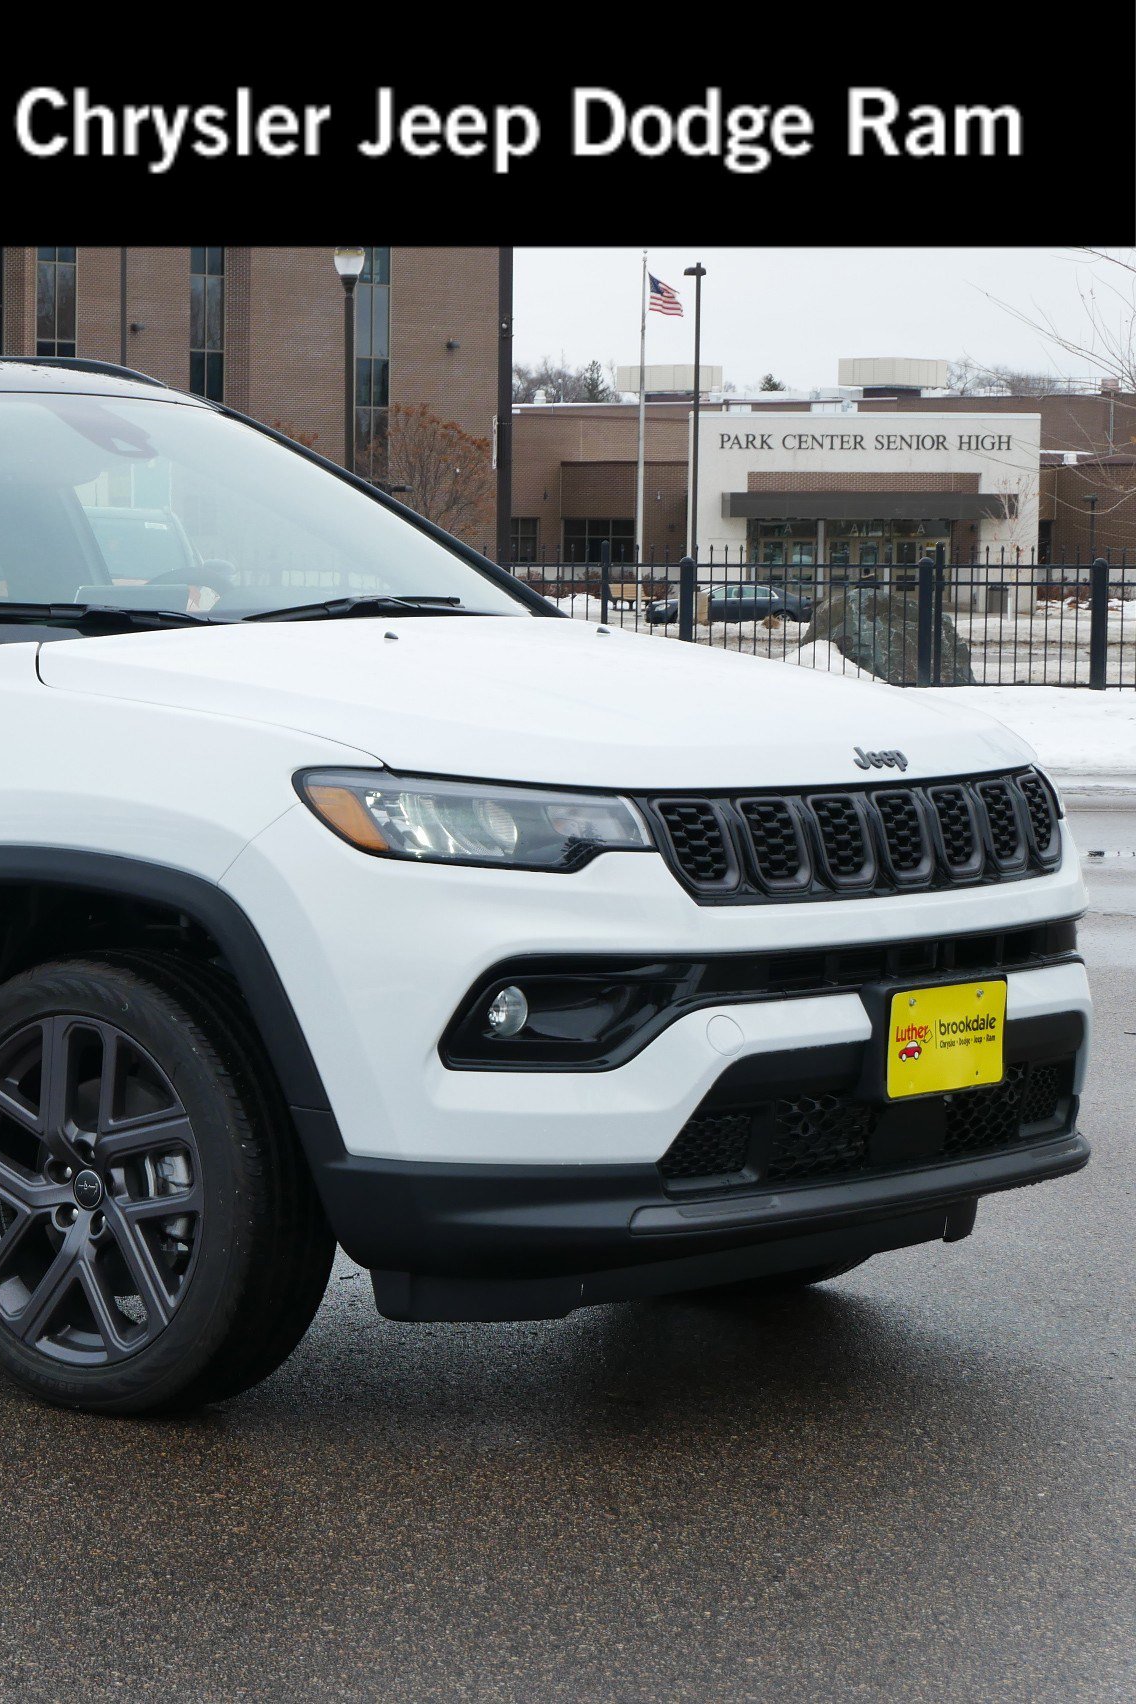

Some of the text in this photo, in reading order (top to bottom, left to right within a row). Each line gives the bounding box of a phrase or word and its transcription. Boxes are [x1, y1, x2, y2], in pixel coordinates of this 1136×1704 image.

[719, 433, 1013, 451] PARK CENTER SENIOR HIGH
[853, 746, 909, 772] Jeep
[895, 1022, 929, 1043] Luther
[938, 1013, 997, 1036] brookdale
